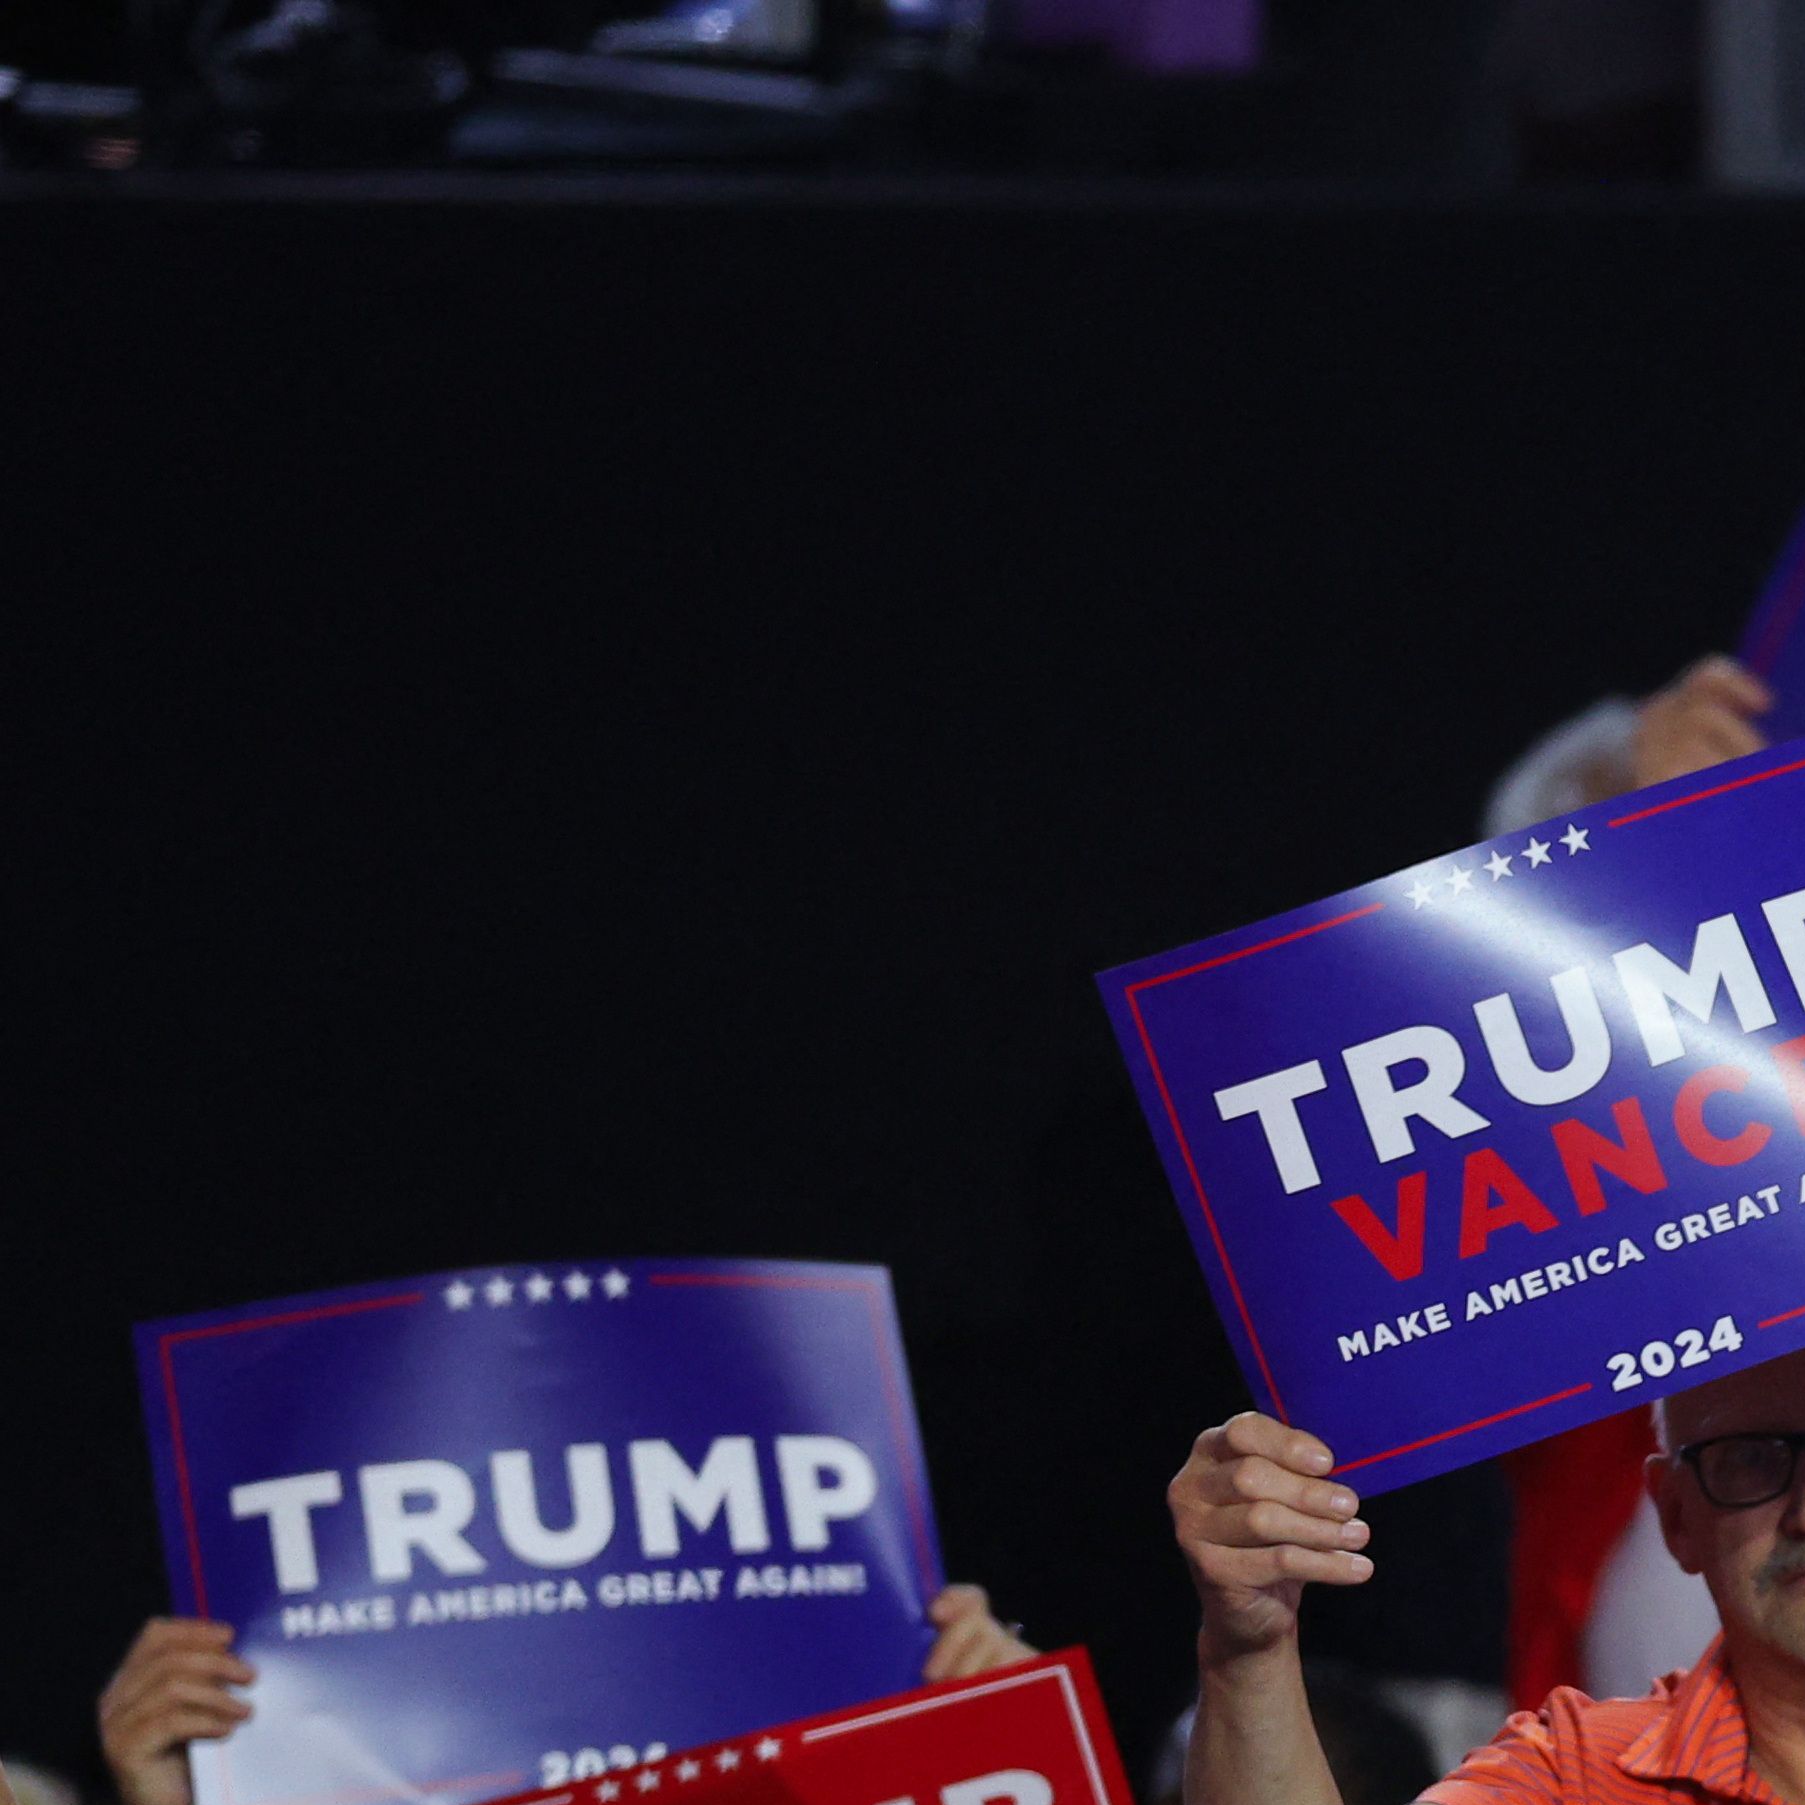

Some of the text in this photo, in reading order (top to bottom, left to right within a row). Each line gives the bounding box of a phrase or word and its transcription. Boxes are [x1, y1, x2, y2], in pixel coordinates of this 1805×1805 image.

[1336, 1303, 1452, 1363] MAKE
[1463, 1237, 1645, 1322] AMERICA
[1655, 1184, 1783, 1252] GREAT
[1605, 1314, 1745, 1393] 2024
[229, 1434, 879, 1596] TRUMP
[282, 1563, 867, 1641] MAKE AMERICA GREAT AGAIN!
